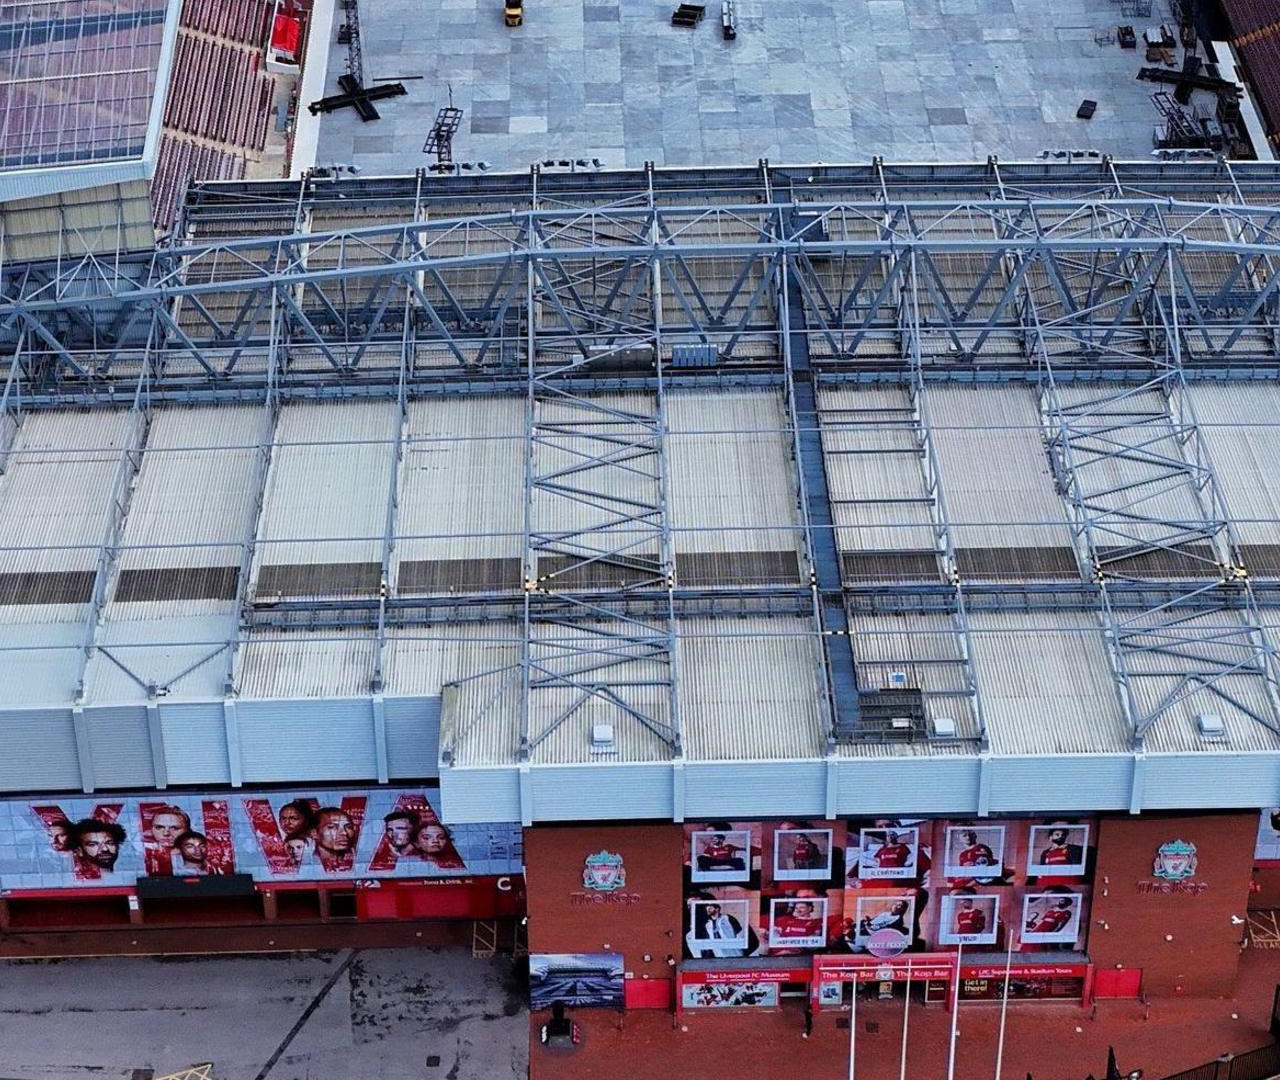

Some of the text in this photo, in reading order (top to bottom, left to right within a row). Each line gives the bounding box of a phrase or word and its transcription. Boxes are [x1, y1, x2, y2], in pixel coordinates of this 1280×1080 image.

[497, 876, 512, 891] C
[570, 890, 640, 907] The Kop
[914, 970, 932, 978] Kop
